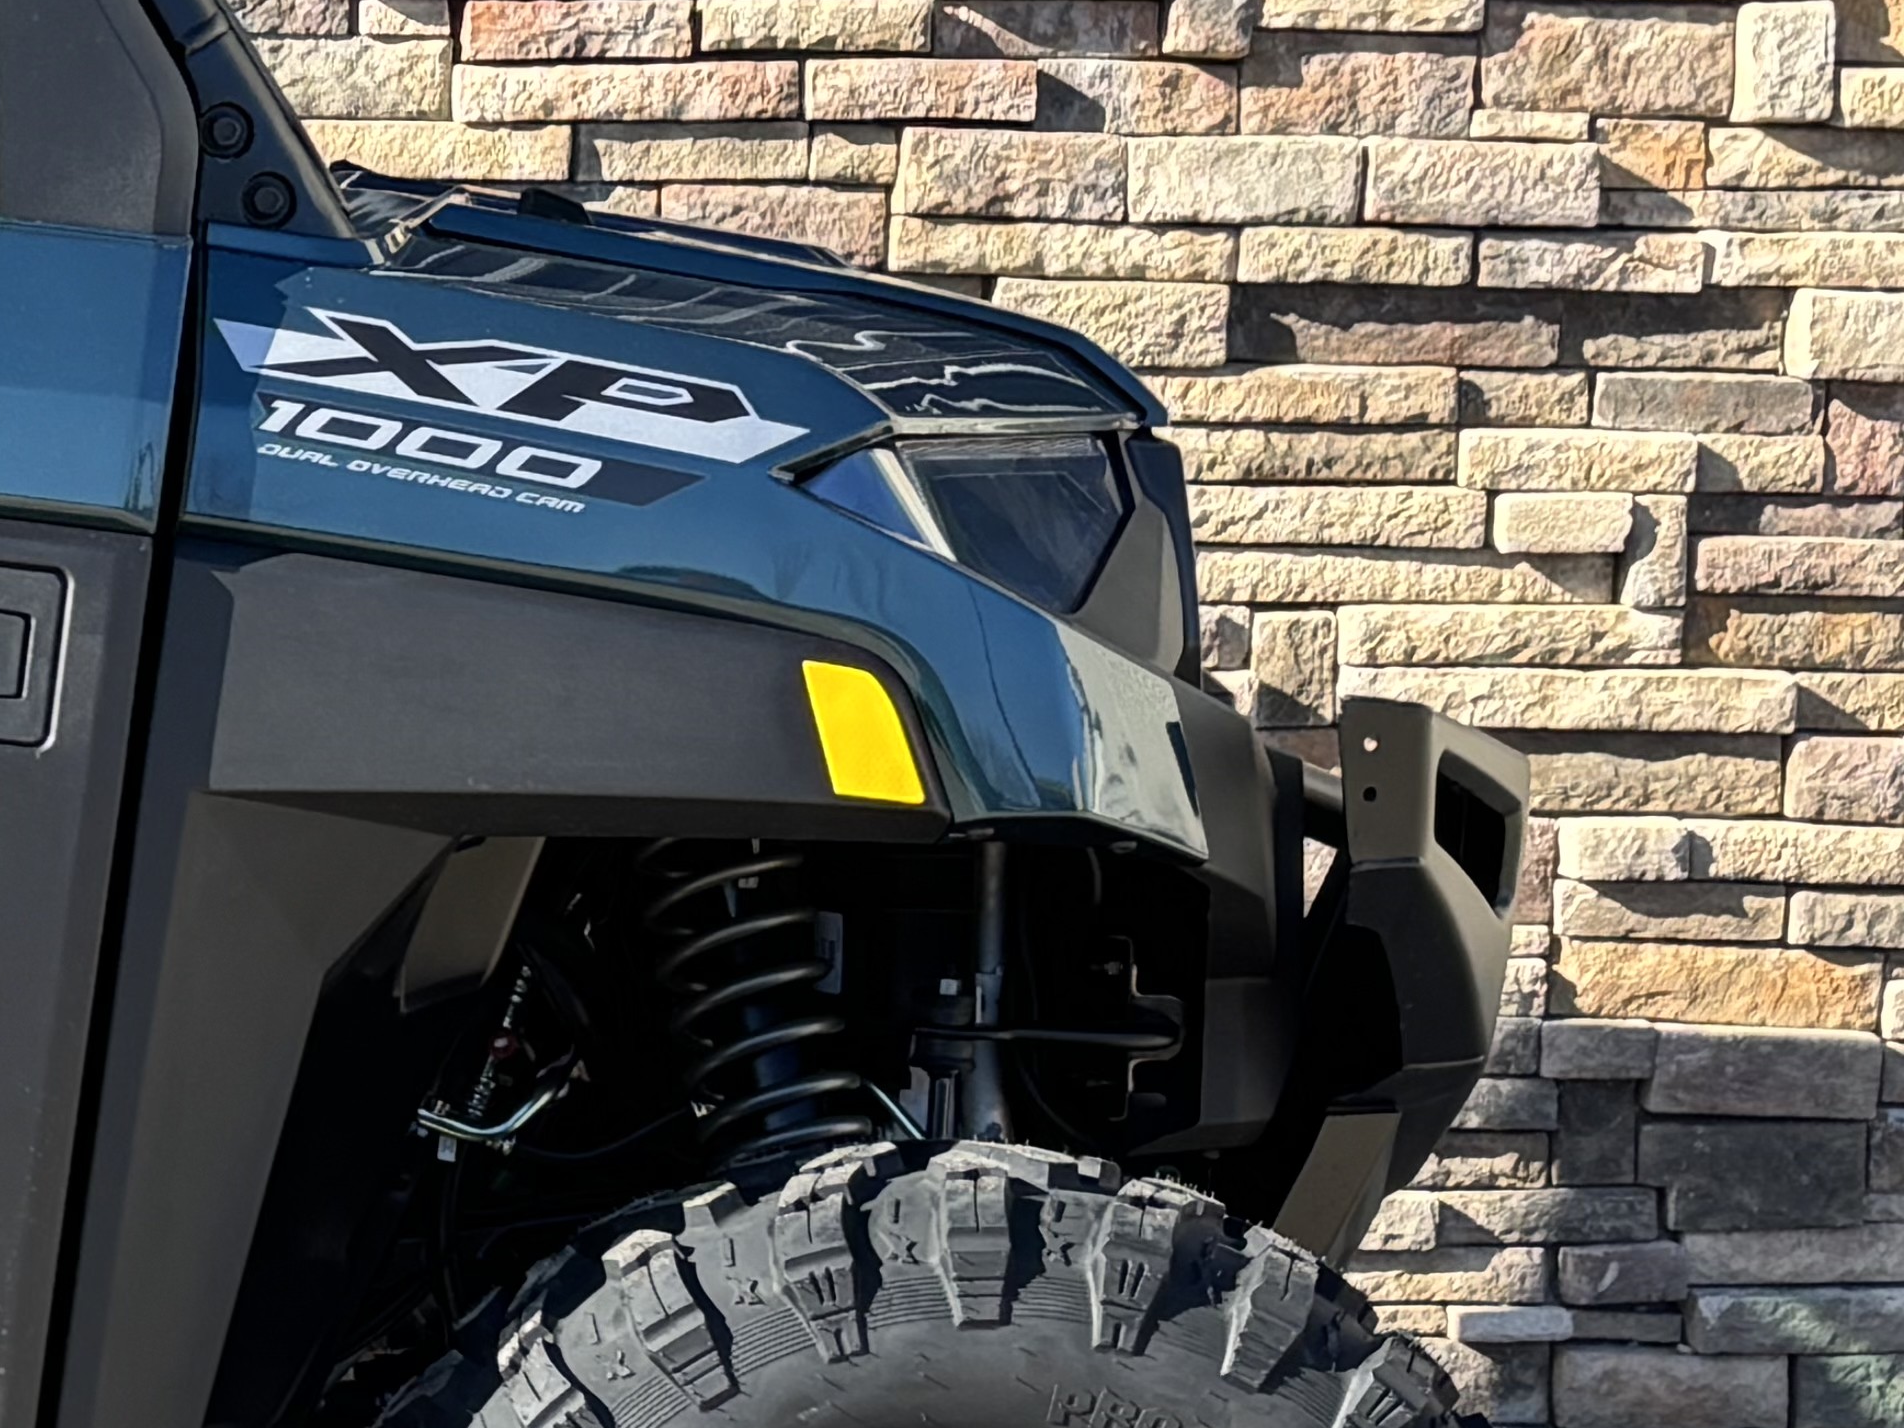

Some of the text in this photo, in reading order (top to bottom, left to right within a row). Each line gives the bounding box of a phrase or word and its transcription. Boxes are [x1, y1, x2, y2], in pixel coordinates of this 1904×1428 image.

[248, 307, 760, 427] XP
[257, 443, 587, 513] DUAL OVERHEAD CAM
[258, 400, 602, 489] 1000
